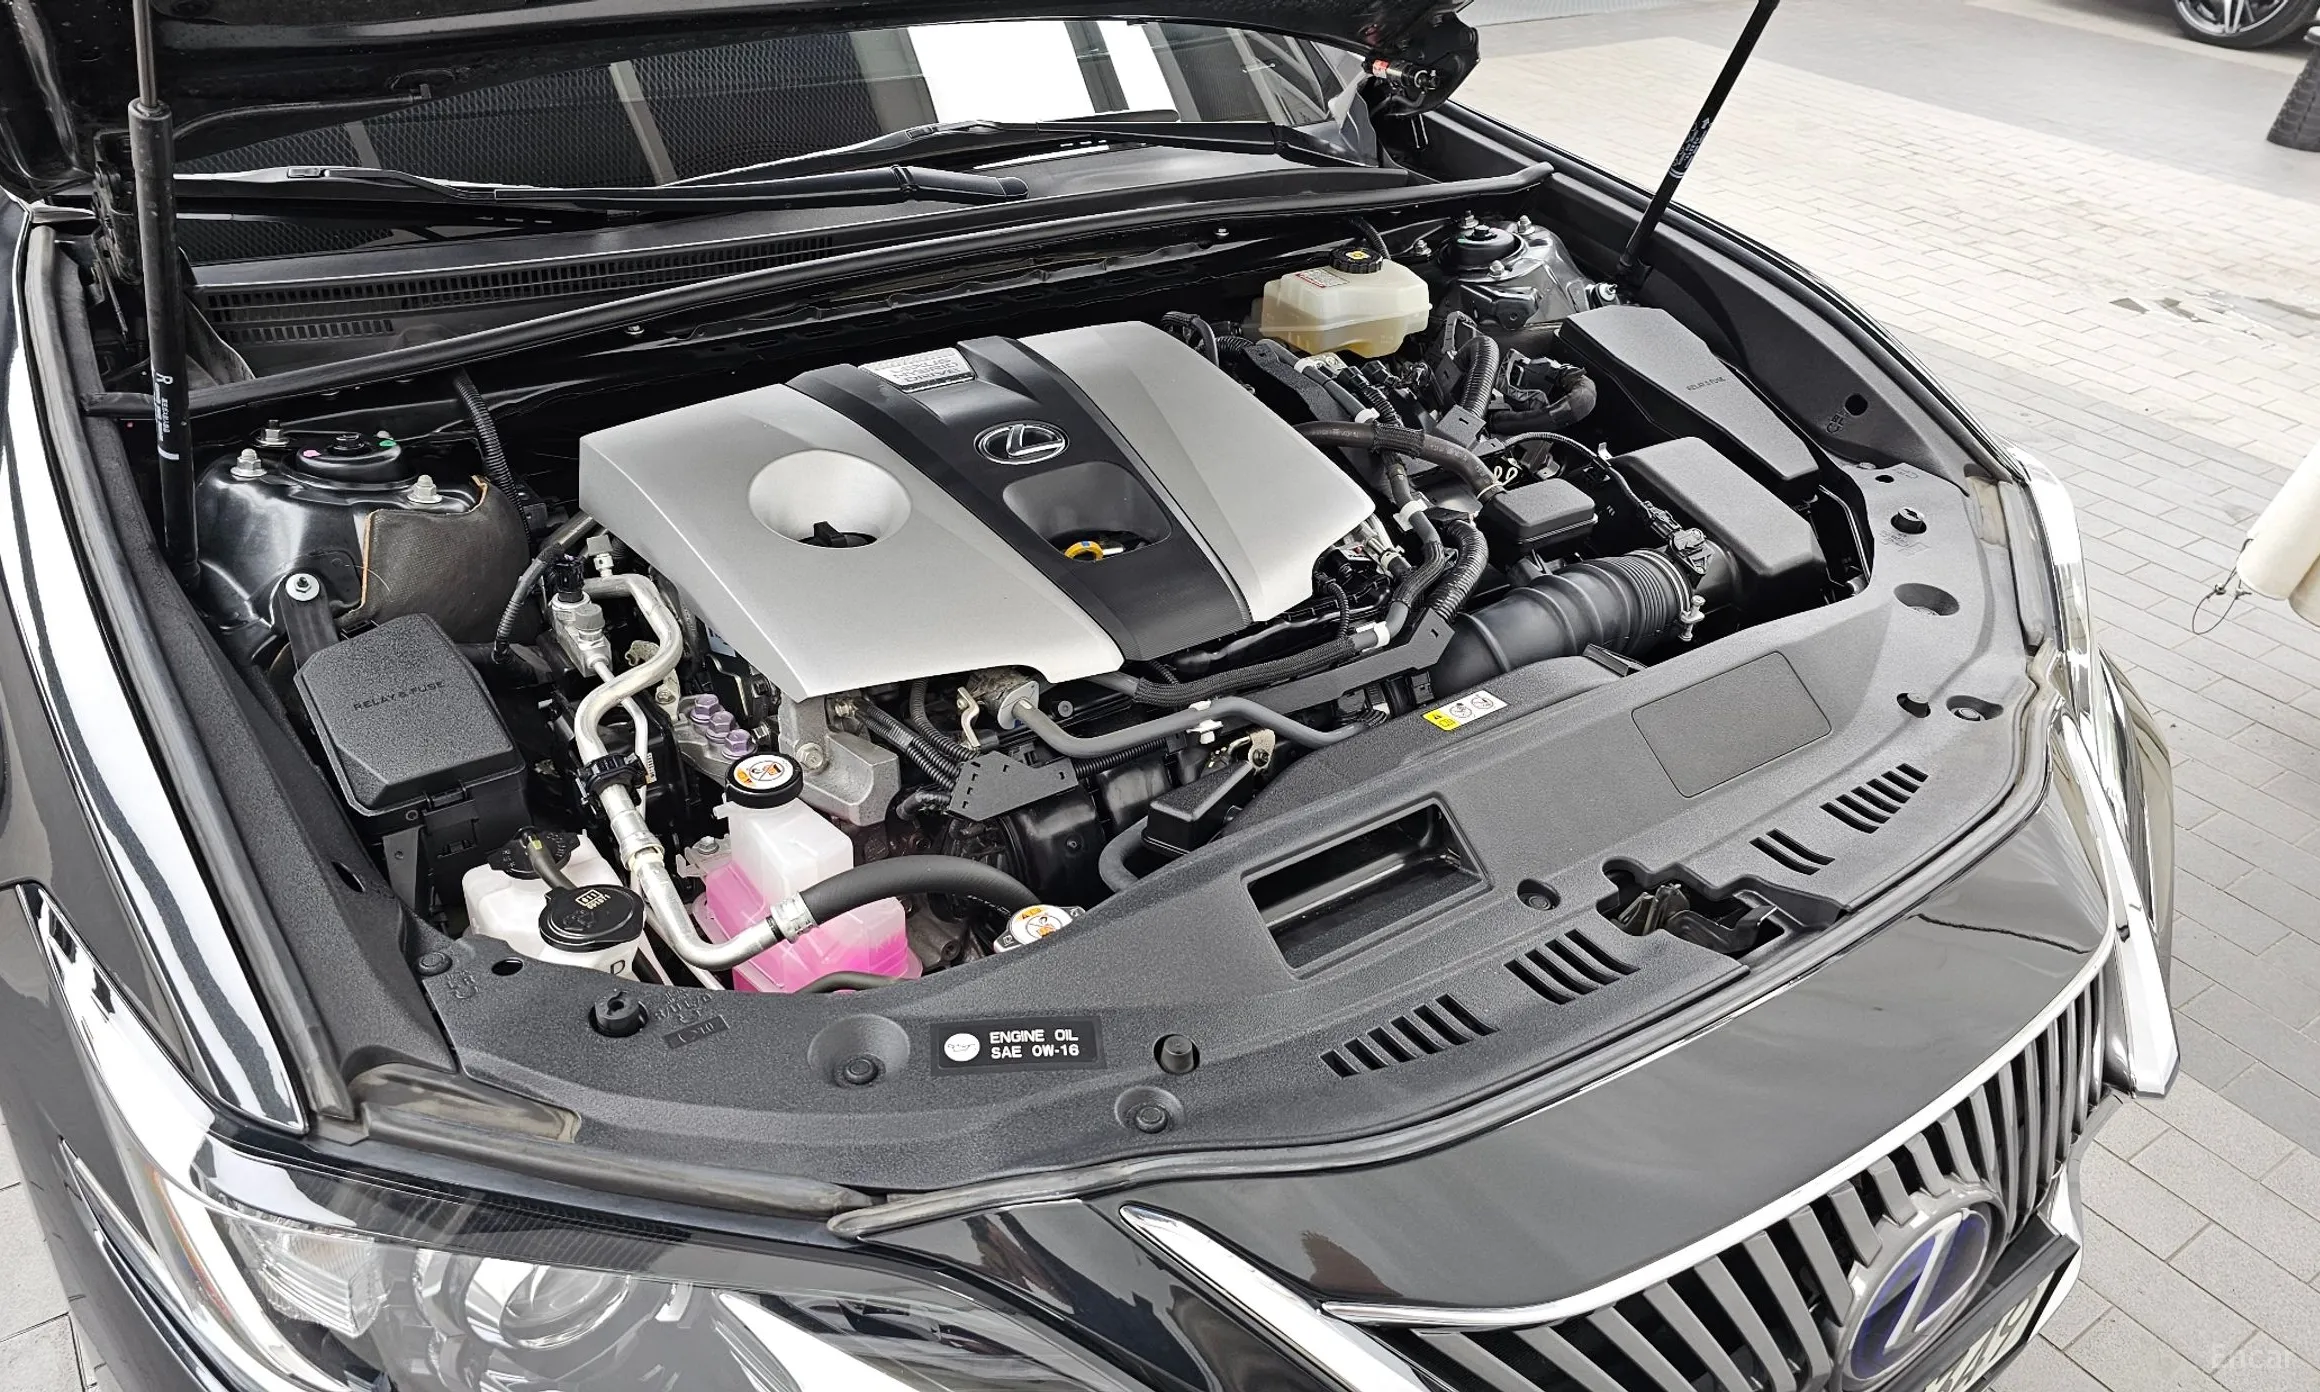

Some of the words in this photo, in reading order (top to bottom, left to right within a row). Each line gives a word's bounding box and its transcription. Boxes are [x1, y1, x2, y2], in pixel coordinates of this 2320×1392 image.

[353, 693, 396, 711] RELAY
[410, 680, 446, 695] FUSE
[989, 1028, 1045, 1044] ENGINE
[1054, 1028, 1079, 1042] OIL
[990, 1045, 1023, 1060] SAE
[1031, 1043, 1080, 1057] 0W-16
